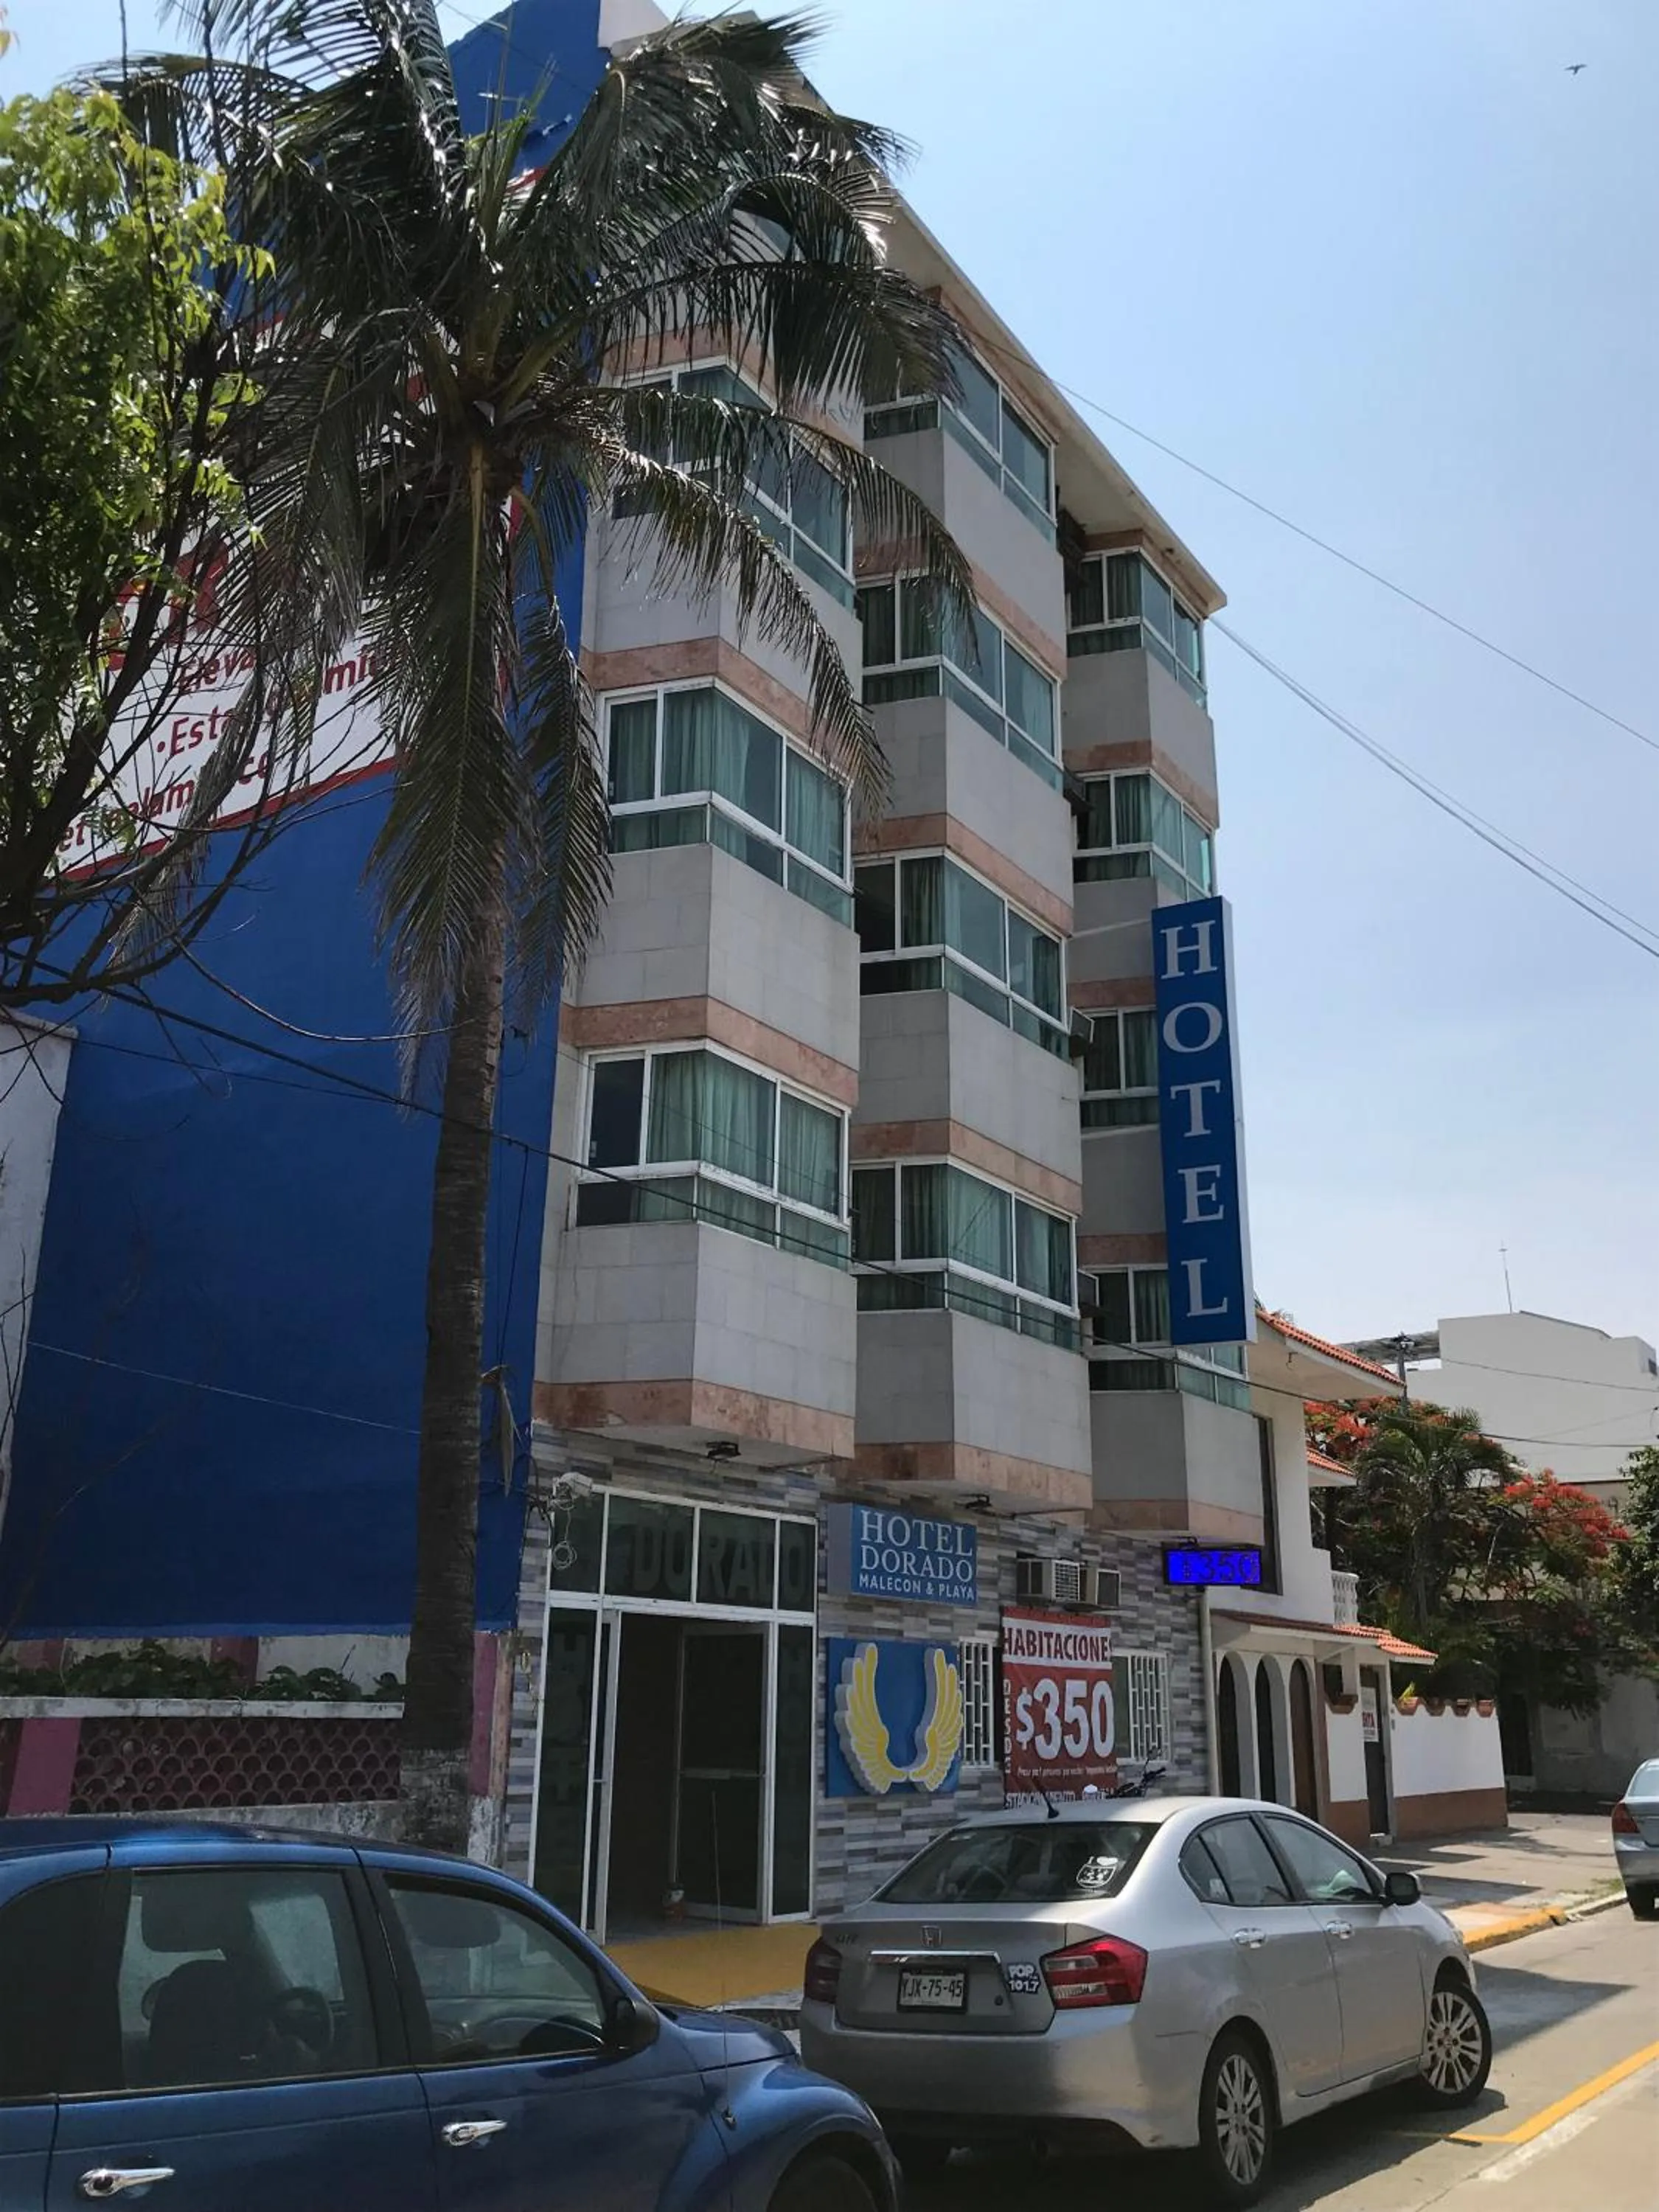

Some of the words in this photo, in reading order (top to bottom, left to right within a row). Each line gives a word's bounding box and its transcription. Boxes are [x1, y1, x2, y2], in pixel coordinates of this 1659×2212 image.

[1160, 919, 1228, 1318] HOTEL
[860, 1510, 973, 1557] HOTEL
[860, 1545, 973, 1582] DORADO
[859, 1573, 921, 1593] MALECON
[925, 1582, 933, 1595] &
[939, 1584, 974, 1600] PLAYA
[1003, 1627, 1112, 1662] HABITACIONE
[1015, 1677, 1115, 1760] $350
